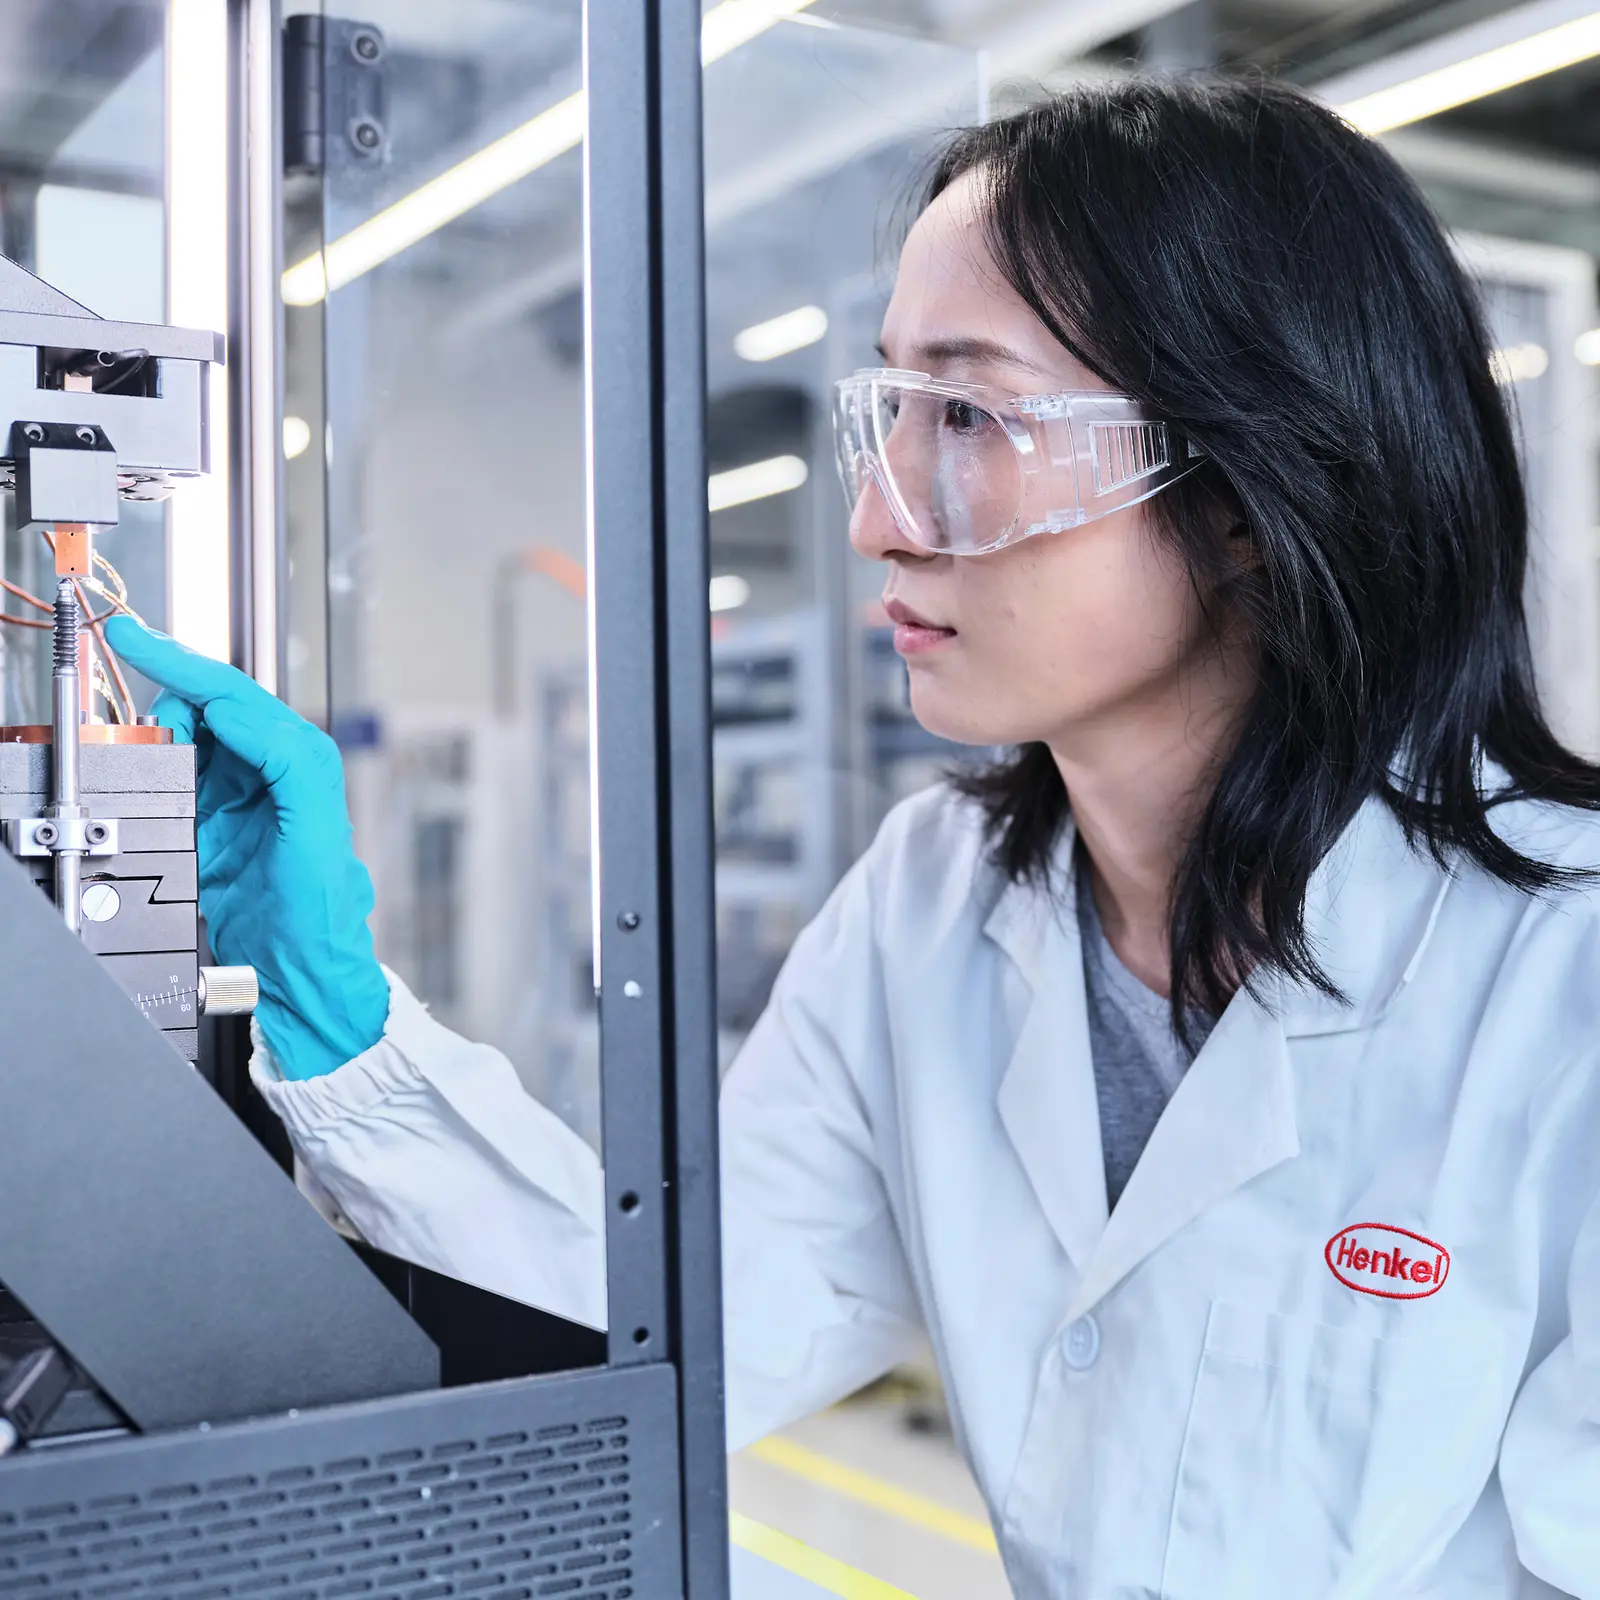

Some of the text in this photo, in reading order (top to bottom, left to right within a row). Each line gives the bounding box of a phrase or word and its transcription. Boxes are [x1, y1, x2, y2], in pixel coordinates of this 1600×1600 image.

[169, 974, 179, 984] 10
[180, 1003, 191, 1012] 60
[1336, 1236, 1442, 1284] Henkel
